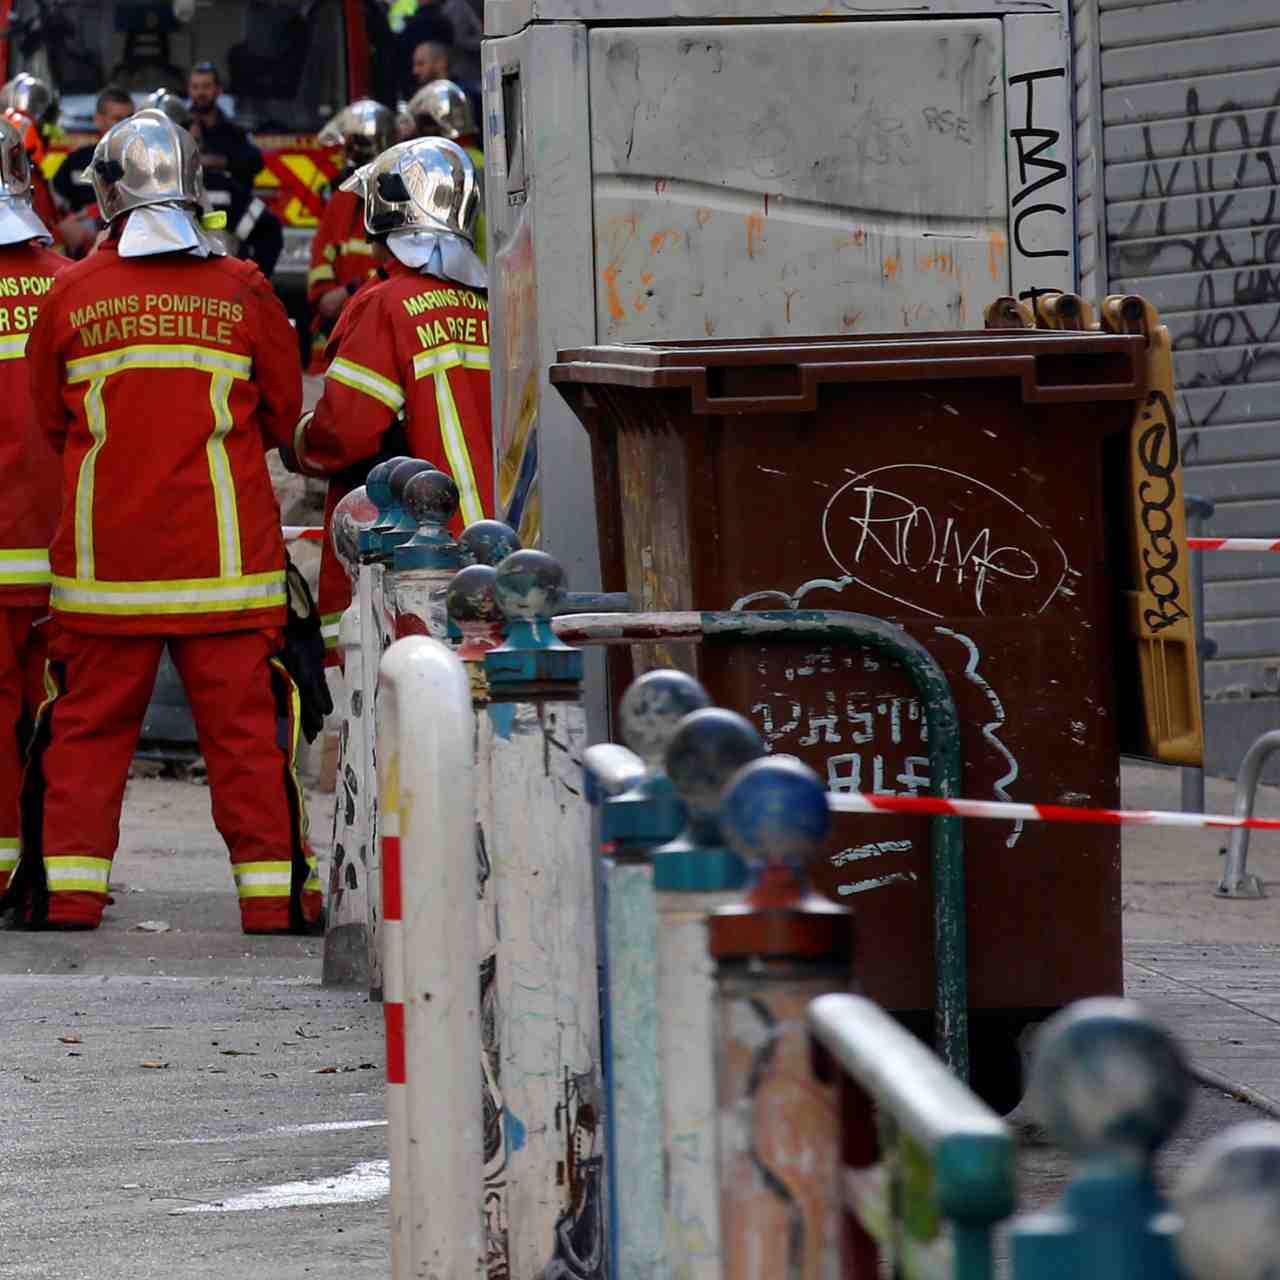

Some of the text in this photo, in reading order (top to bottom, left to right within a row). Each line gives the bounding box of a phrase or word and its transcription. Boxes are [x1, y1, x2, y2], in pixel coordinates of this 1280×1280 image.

[69, 293, 244, 329] MARINS POMPIERS
[402, 288, 460, 318] MARINS
[79, 313, 233, 349] MARSEILLE
